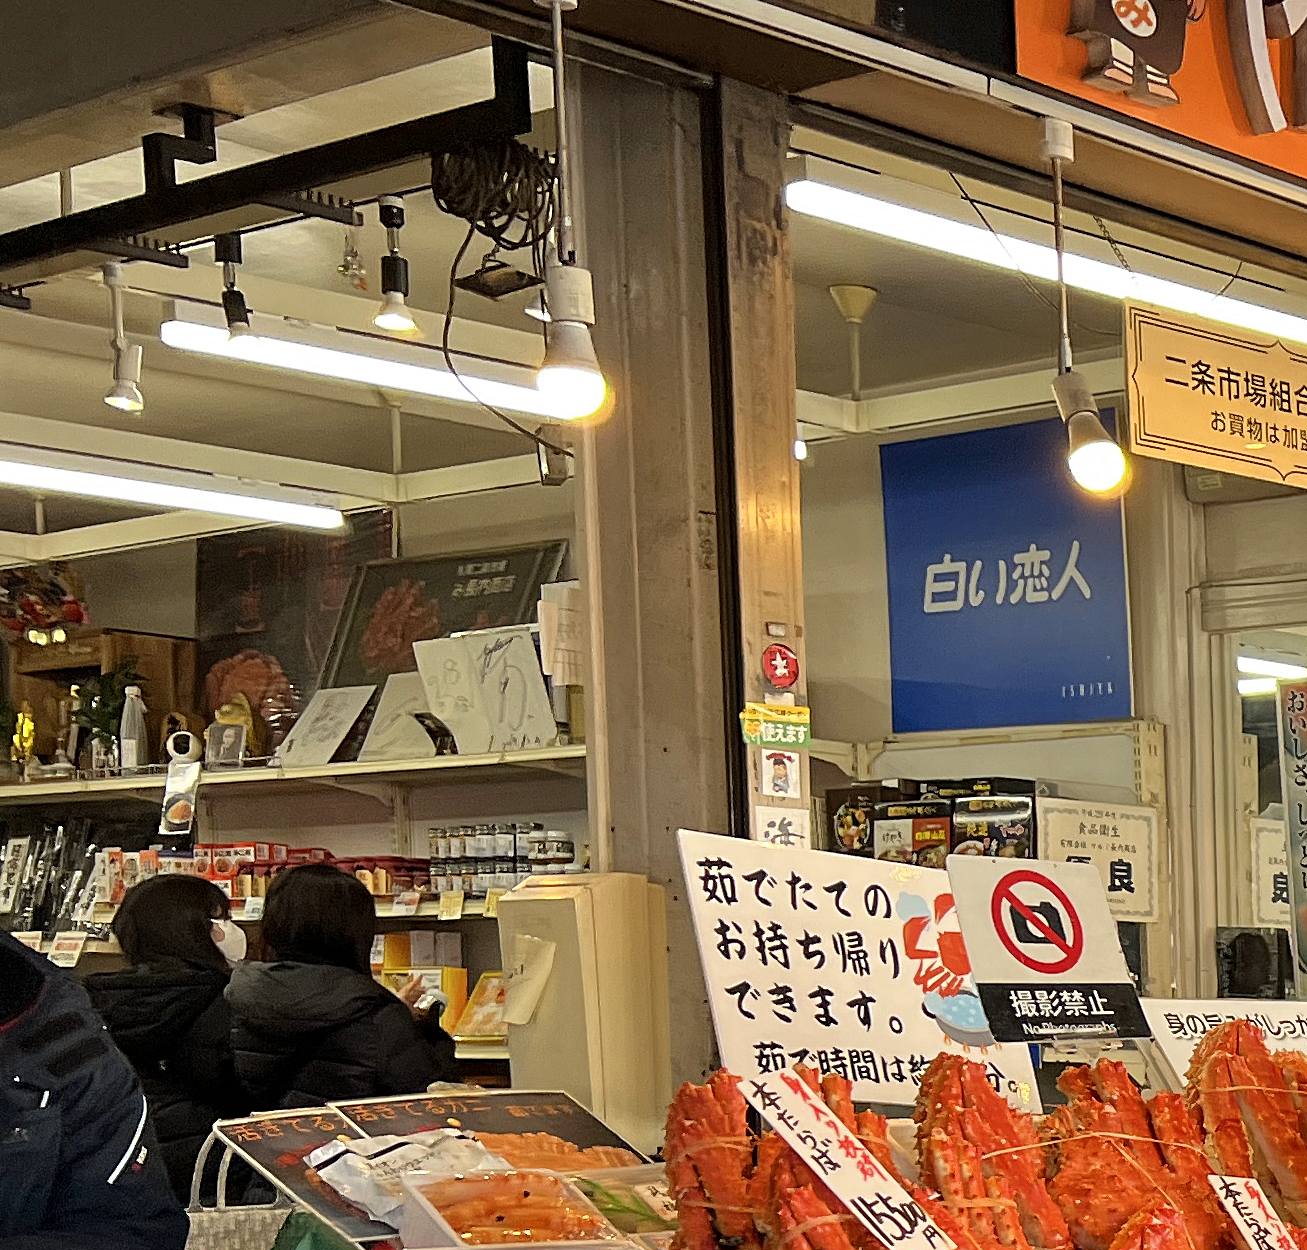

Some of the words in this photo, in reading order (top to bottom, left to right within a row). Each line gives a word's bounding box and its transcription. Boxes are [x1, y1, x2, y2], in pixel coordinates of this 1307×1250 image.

[922, 540, 1092, 614] 白い恋人
[696, 856, 893, 919] 茹でたての
[713, 918, 901, 980] お持ち帰り
[723, 980, 904, 1035] できます。
[1008, 989, 1115, 1018] 撮影禁止
